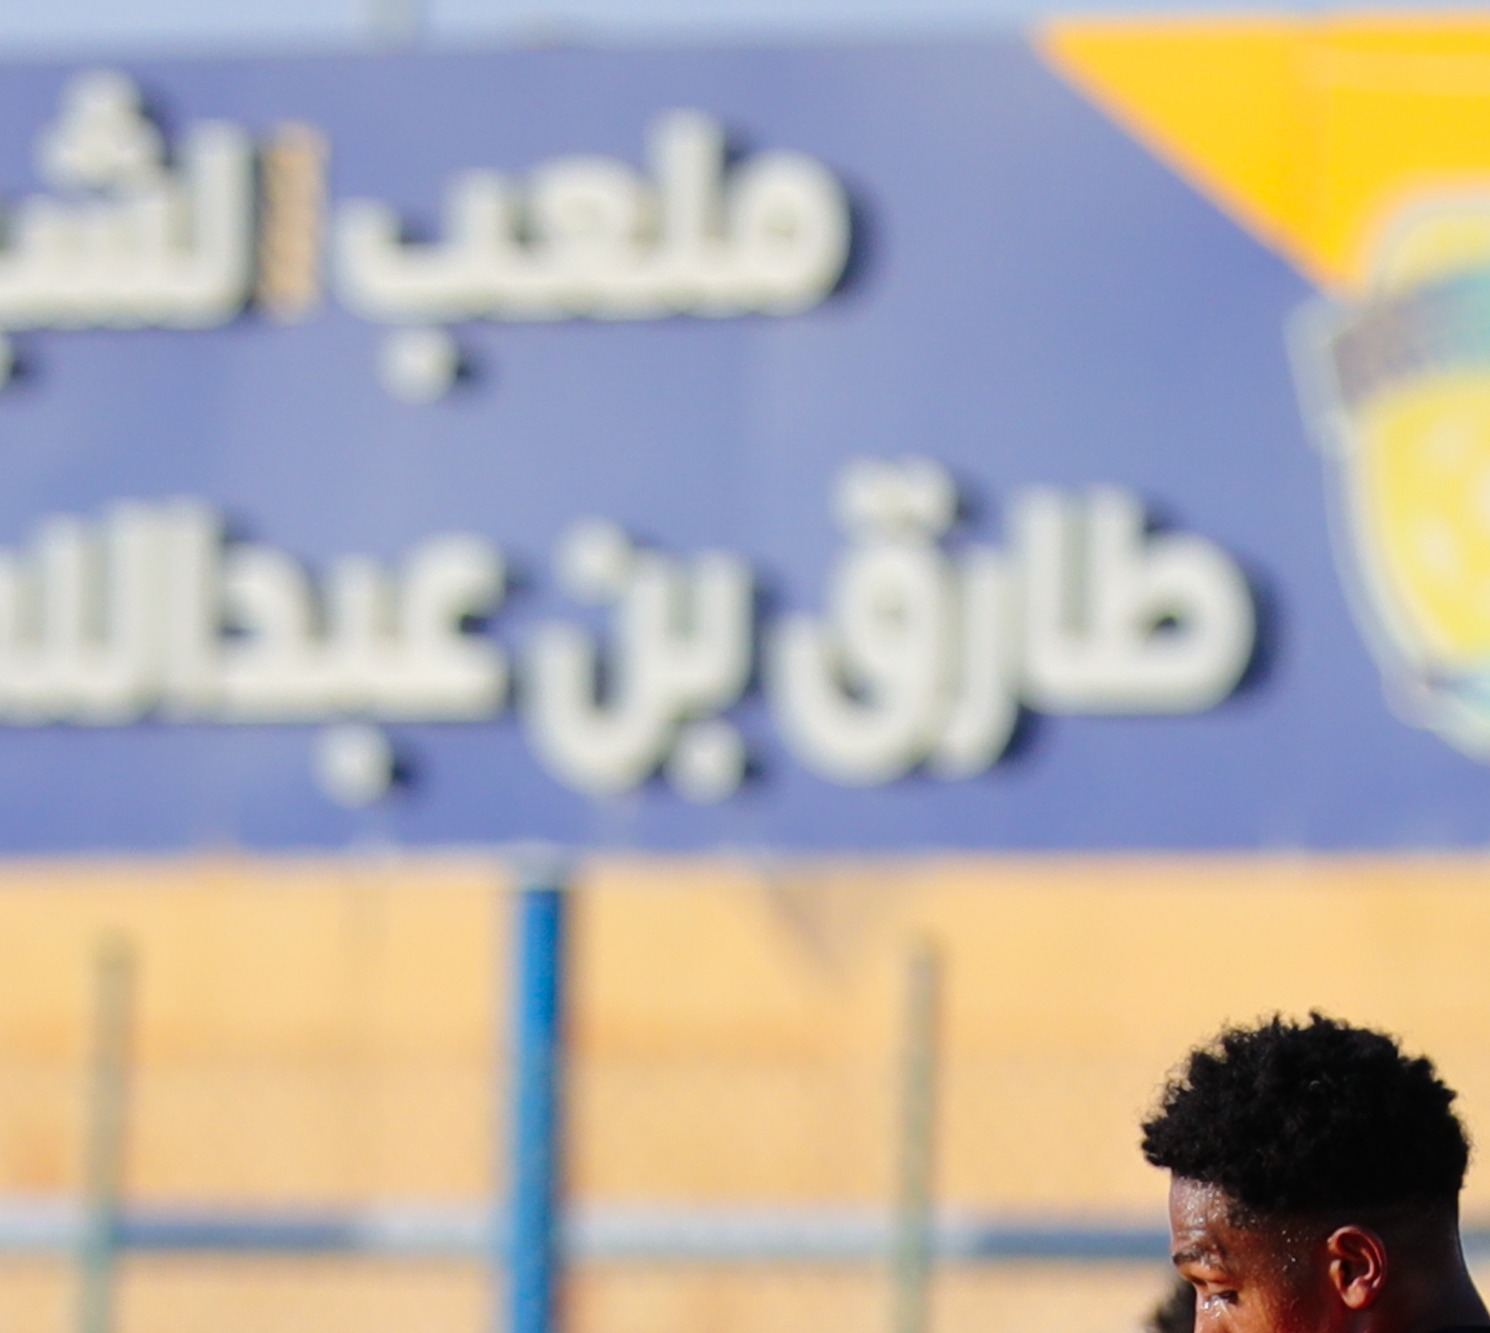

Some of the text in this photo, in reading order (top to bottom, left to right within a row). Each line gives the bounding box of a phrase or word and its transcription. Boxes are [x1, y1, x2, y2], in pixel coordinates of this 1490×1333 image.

[0, 68, 856, 404] ملعب الش
[0, 454, 1260, 804] طارق بن عبدالل
